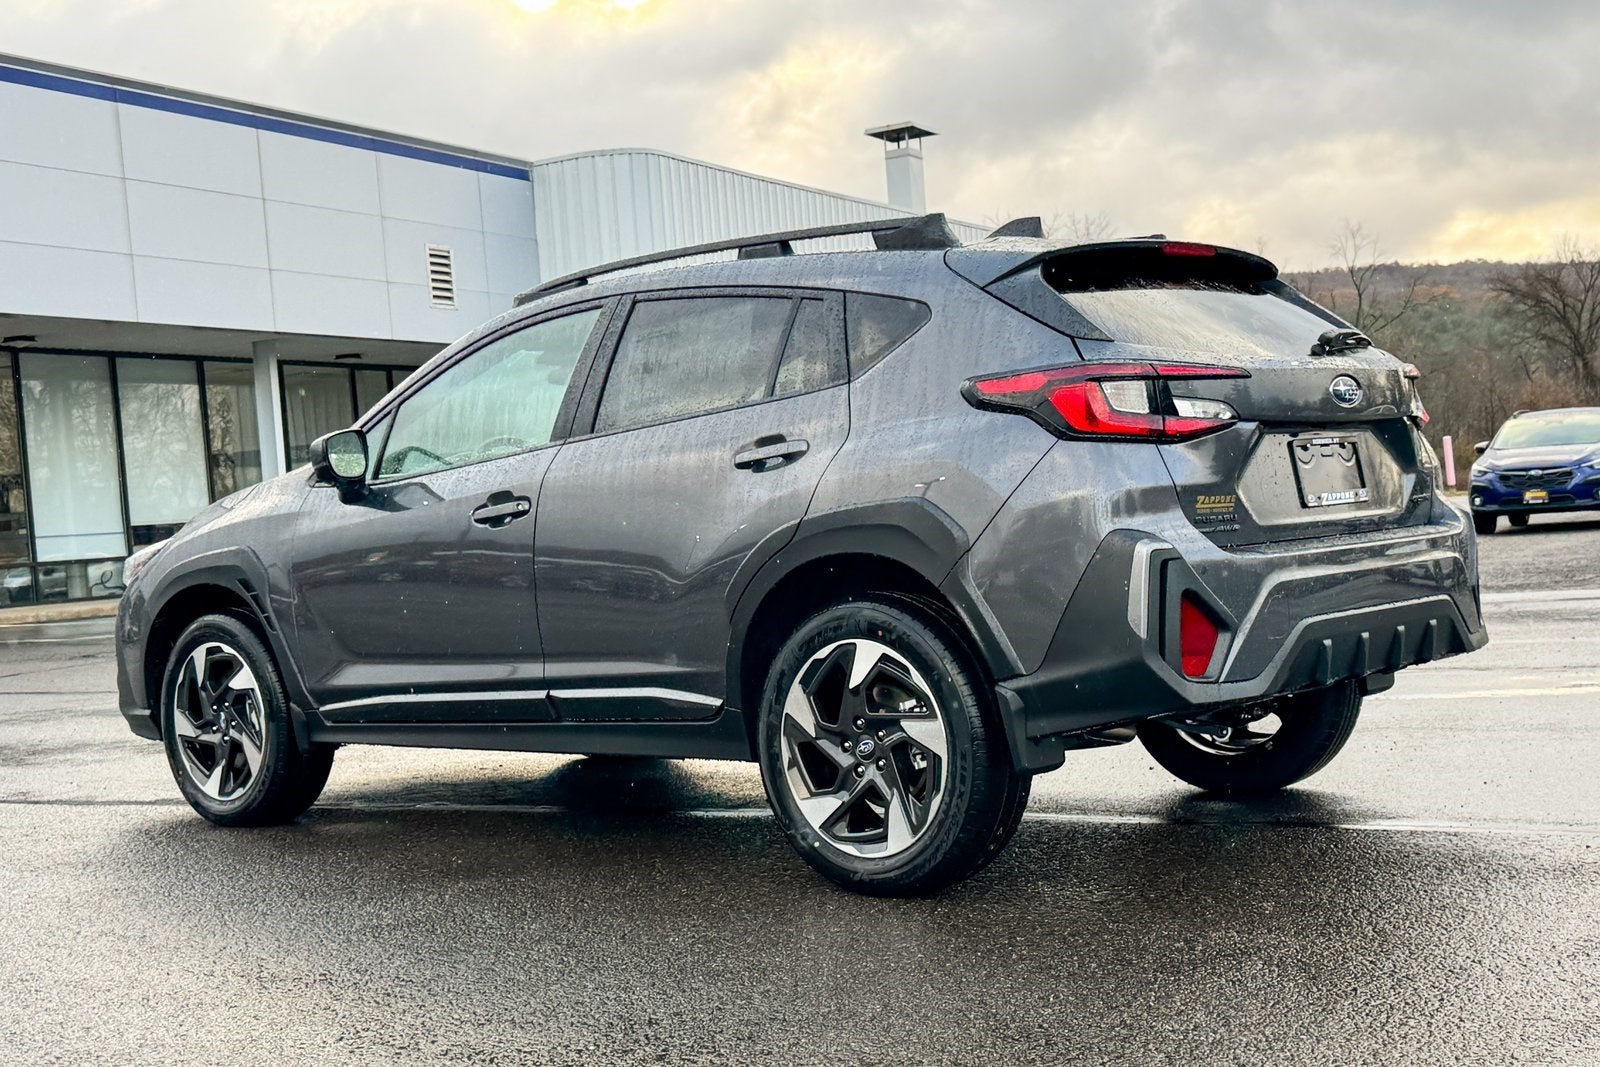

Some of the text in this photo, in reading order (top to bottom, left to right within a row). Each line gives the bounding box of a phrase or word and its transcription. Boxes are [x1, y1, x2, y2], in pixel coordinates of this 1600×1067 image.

[1195, 495, 1236, 508] ZAPPONE
[1321, 491, 1355, 506] ZAPPONE
[1194, 514, 1238, 523] SUBARU
